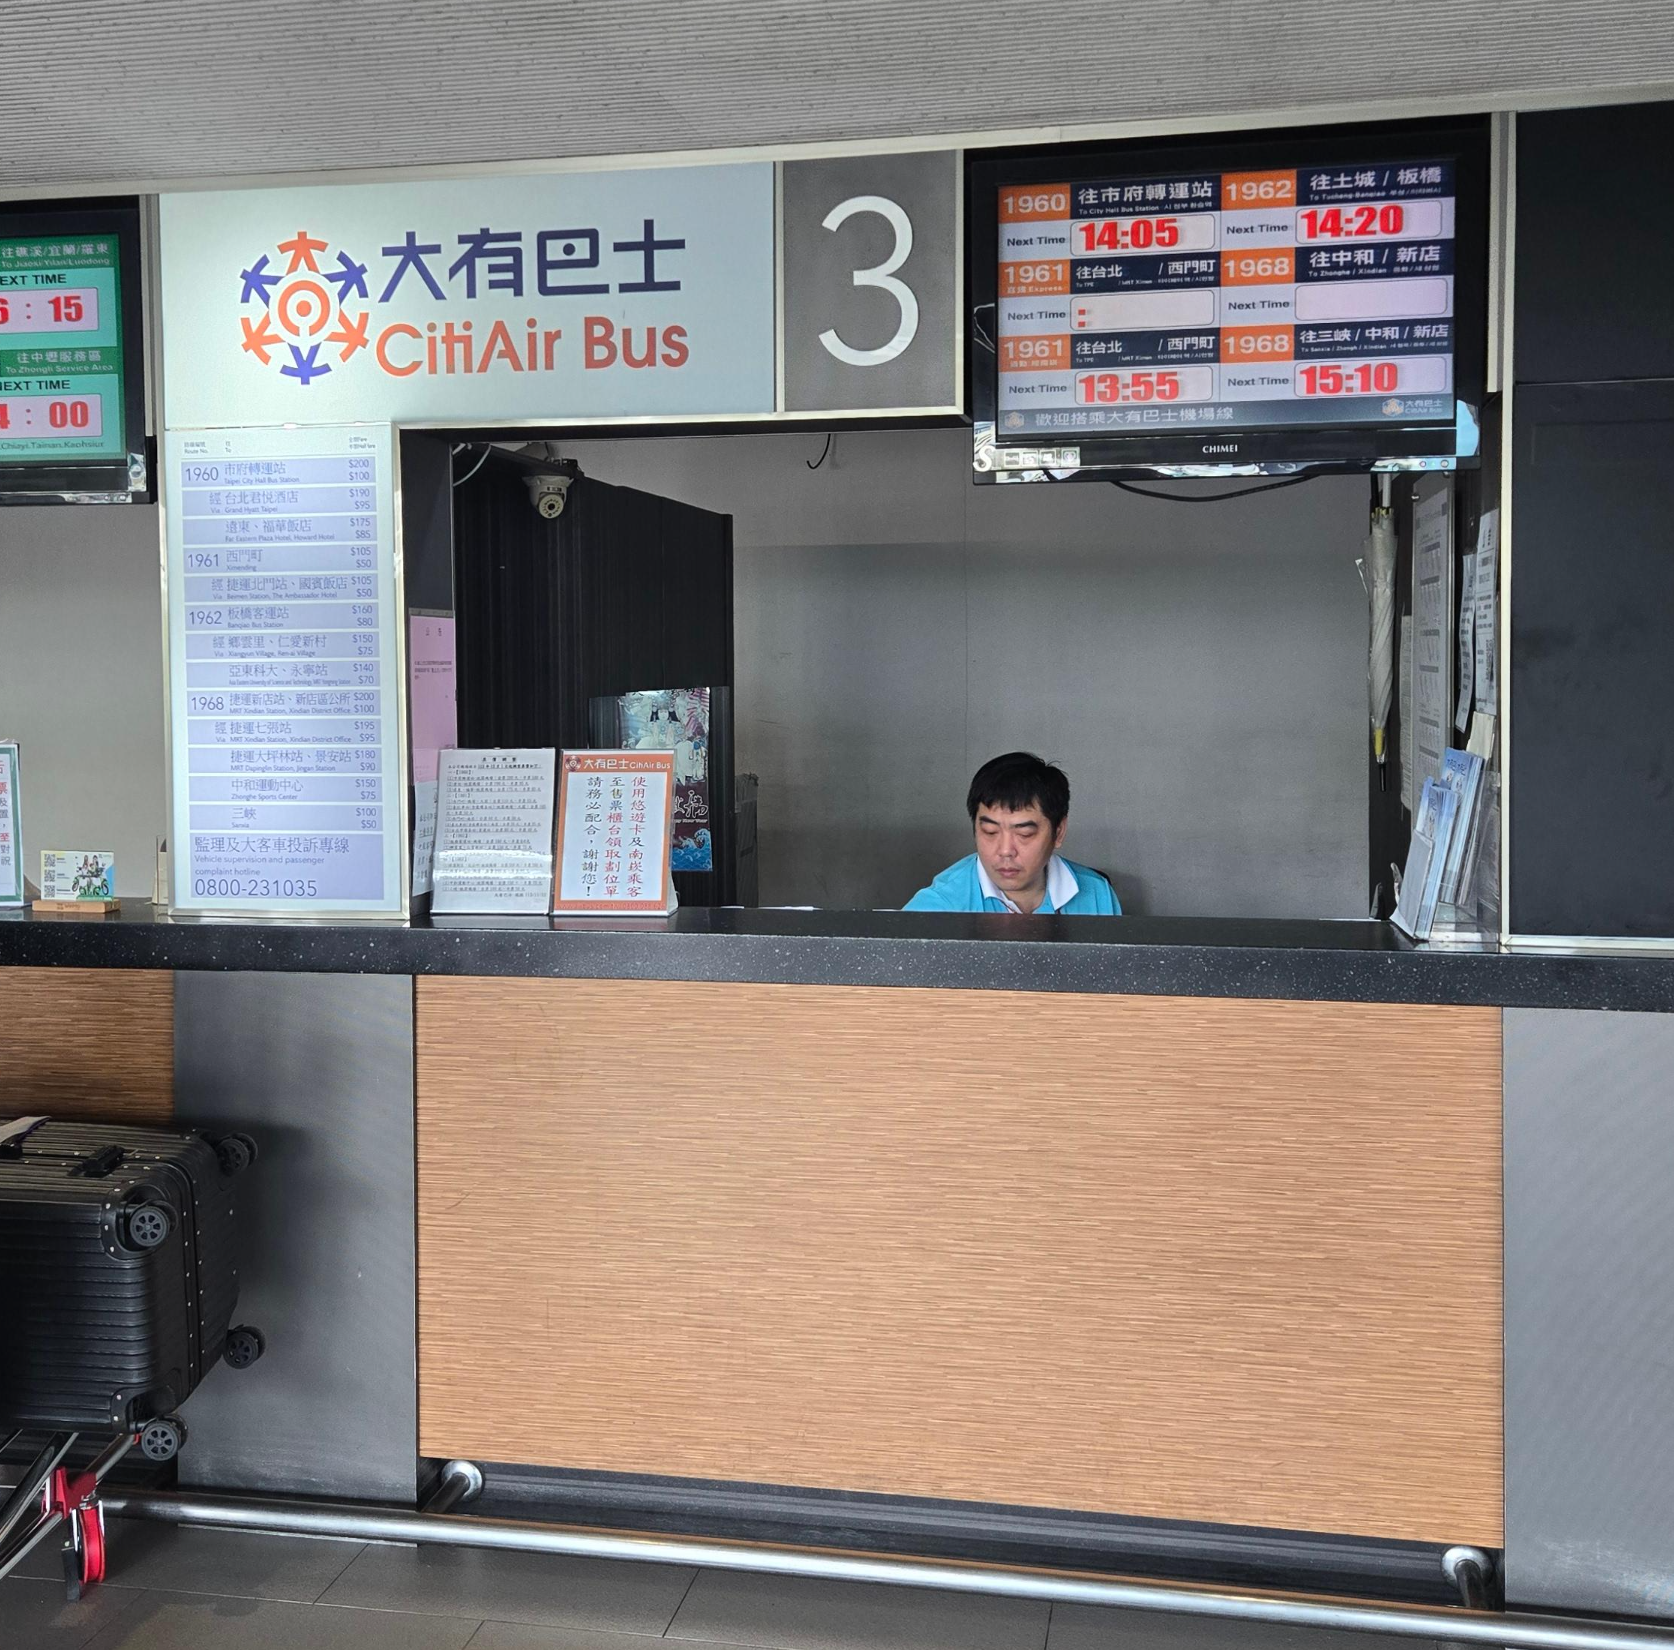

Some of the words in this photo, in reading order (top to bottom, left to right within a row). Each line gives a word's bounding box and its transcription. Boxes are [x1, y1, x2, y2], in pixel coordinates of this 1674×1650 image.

[1310, 171, 1376, 191] 往土城
[1396, 166, 1442, 185] 板橋
[1078, 181, 1213, 204] 往市府轉運站
[1226, 180, 1292, 201] 1962
[1004, 194, 1066, 214] 1960
[1301, 205, 1404, 239] 14:20
[1079, 218, 1179, 251] 14:05
[1227, 225, 1255, 235] Next
[1258, 224, 1289, 232] Time
[1007, 237, 1034, 247] Next
[1037, 237, 1066, 245] Time
[379, 218, 686, 303] 大有巴士
[1310, 249, 1375, 268] 往中和
[1396, 246, 1441, 263] 新店
[1076, 264, 1123, 280] 往台北
[1168, 260, 1216, 275] 西門町
[1225, 258, 1290, 278] 1968
[1004, 264, 1064, 284] 1961
[0, 275, 28, 286] EXT
[32, 274, 67, 284] TIME
[818, 195, 921, 367] 3
[48, 296, 83, 323] 15
[1228, 302, 1257, 311] Next
[1260, 300, 1290, 309] Time
[1008, 311, 1034, 321] Next
[1037, 310, 1066, 320] Time
[1300, 329, 1352, 344] 往三峽
[1365, 327, 1400, 341] 中和
[1413, 324, 1449, 338] 新店
[584, 317, 690, 370] Bus
[1004, 339, 1064, 359] 1961
[1076, 340, 1123, 355] 往台北
[1167, 336, 1215, 351] 西門町
[1224, 335, 1290, 355] 1968
[1228, 377, 1256, 387] Next
[1259, 376, 1289, 385] Time
[1300, 363, 1399, 395] 15:10
[0, 381, 32, 391] EXT
[37, 380, 71, 390] TIME
[1009, 385, 1036, 394] Next
[1038, 384, 1067, 393] Time
[1078, 372, 1180, 403] 13:55
[49, 401, 89, 429] 00
[1035, 407, 1234, 427] 歡迎搭乘大有巴士機場線
[1202, 445, 1238, 454] CHIMEI
[224, 463, 286, 476] 市府轉運站
[349, 459, 370, 469] $200
[185, 467, 219, 481] 1960
[349, 471, 370, 481] $100
[349, 488, 370, 498] $190
[355, 501, 370, 510] $95
[350, 517, 371, 527] $175
[355, 530, 371, 539] $85
[226, 549, 263, 563] 西門町
[351, 547, 371, 556] $105
[188, 554, 220, 568] 1961
[356, 559, 372, 568] $50
[351, 576, 372, 585] $105
[357, 588, 373, 597] $50
[228, 606, 289, 620] 板橋客運站
[352, 605, 373, 614] $160
[189, 611, 223, 625] 1962
[357, 617, 373, 626] $80
[352, 634, 374, 643] $150
[358, 646, 374, 655] $75
[353, 663, 374, 673] $140
[358, 676, 374, 685] $70
[354, 692, 375, 701] $200
[191, 697, 225, 711] 1968
[354, 704, 375, 714] $100
[355, 721, 375, 730] $195
[360, 733, 375, 743] $95
[355, 750, 376, 759] $180
[360, 762, 376, 772] $90
[583, 759, 630, 769] 大有巴士
[231, 779, 304, 793] 中和運動中心
[355, 779, 376, 788] $150
[361, 791, 377, 800] $75
[232, 807, 257, 821] 三峽
[356, 808, 377, 817] $100
[361, 820, 377, 829] $50
[194, 837, 350, 854] 監理及大客車投訴專線
[195, 855, 222, 864] Vehicle
[224, 856, 267, 866] supervision
[269, 856, 283, 864] and
[285, 857, 325, 866] passenger
[195, 867, 233, 877] complaint
[235, 867, 261, 876] hotline
[195, 879, 318, 897] 0800-231035
